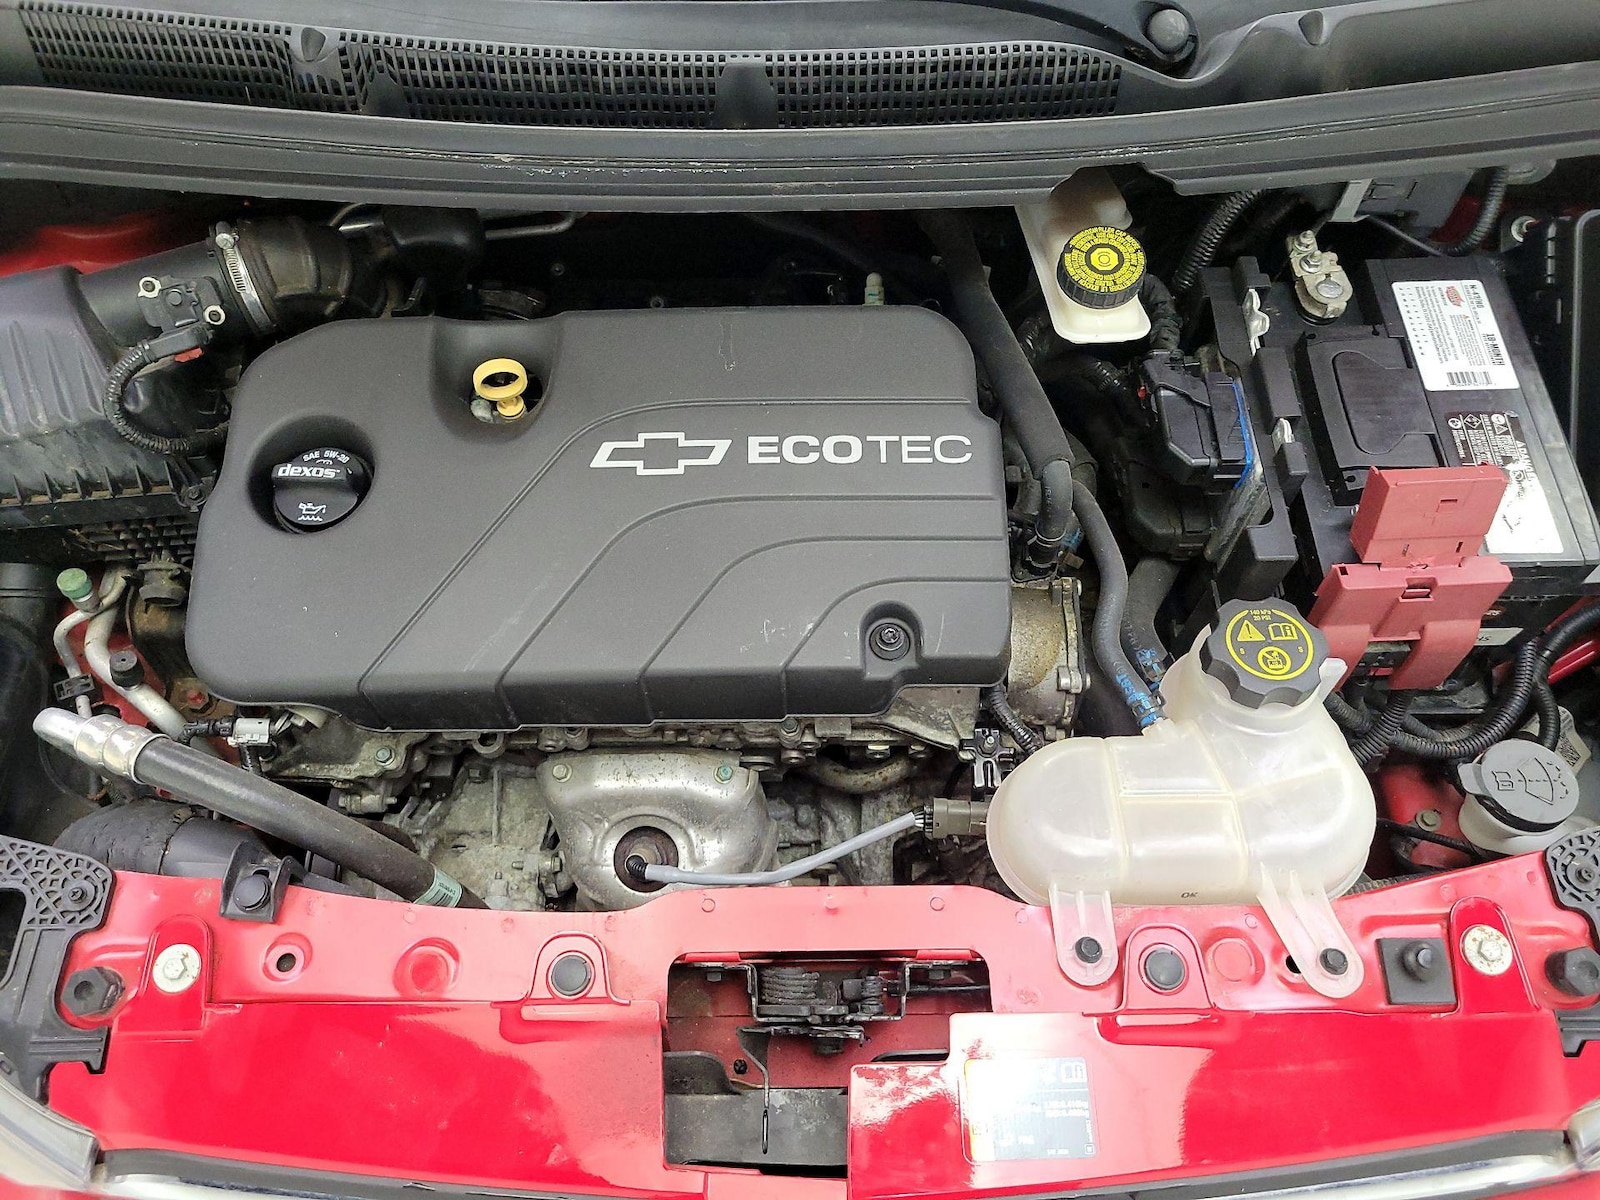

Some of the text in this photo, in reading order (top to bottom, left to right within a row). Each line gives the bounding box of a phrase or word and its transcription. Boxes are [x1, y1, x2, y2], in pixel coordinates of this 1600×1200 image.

[302, 450, 350, 464] SAE 5W-20
[747, 434, 973, 464] ECOTEC
